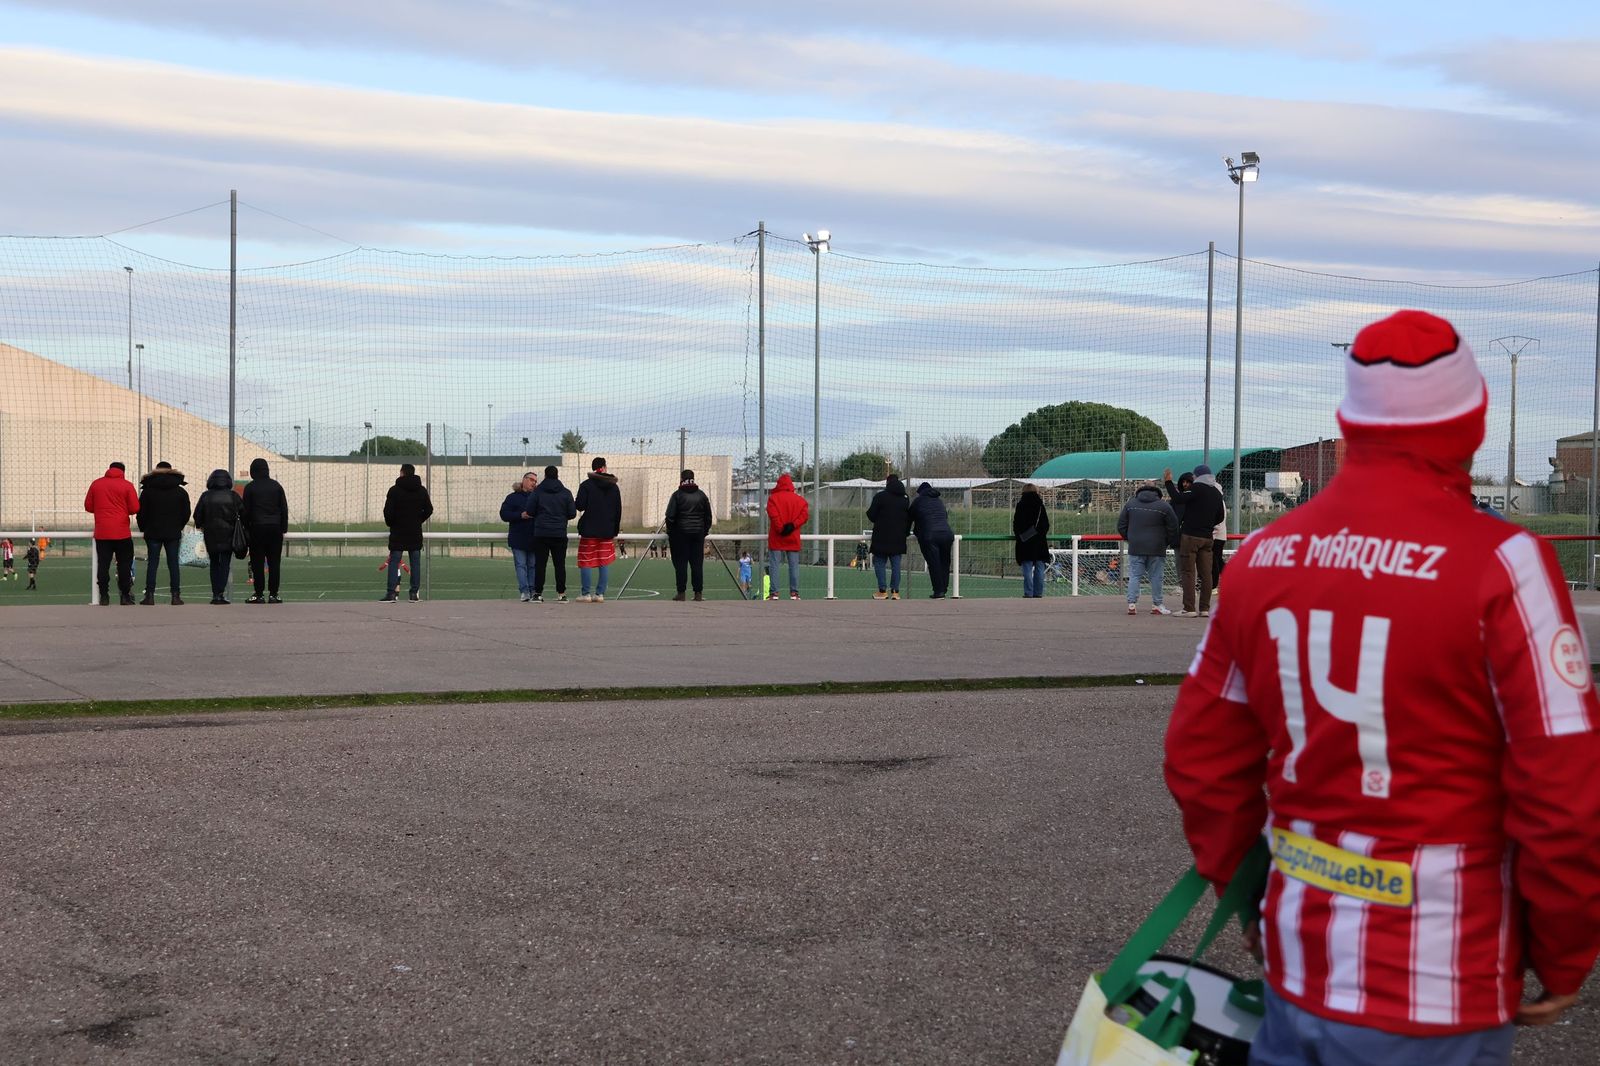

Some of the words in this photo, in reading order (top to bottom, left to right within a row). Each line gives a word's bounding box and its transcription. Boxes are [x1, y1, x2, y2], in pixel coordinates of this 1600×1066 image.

[1248, 534, 1302, 568] KIKE
[1304, 527, 1447, 580] MÁRQUEZ
[1266, 607, 1391, 799] 14
[1273, 834, 1404, 895] Rapimueble
